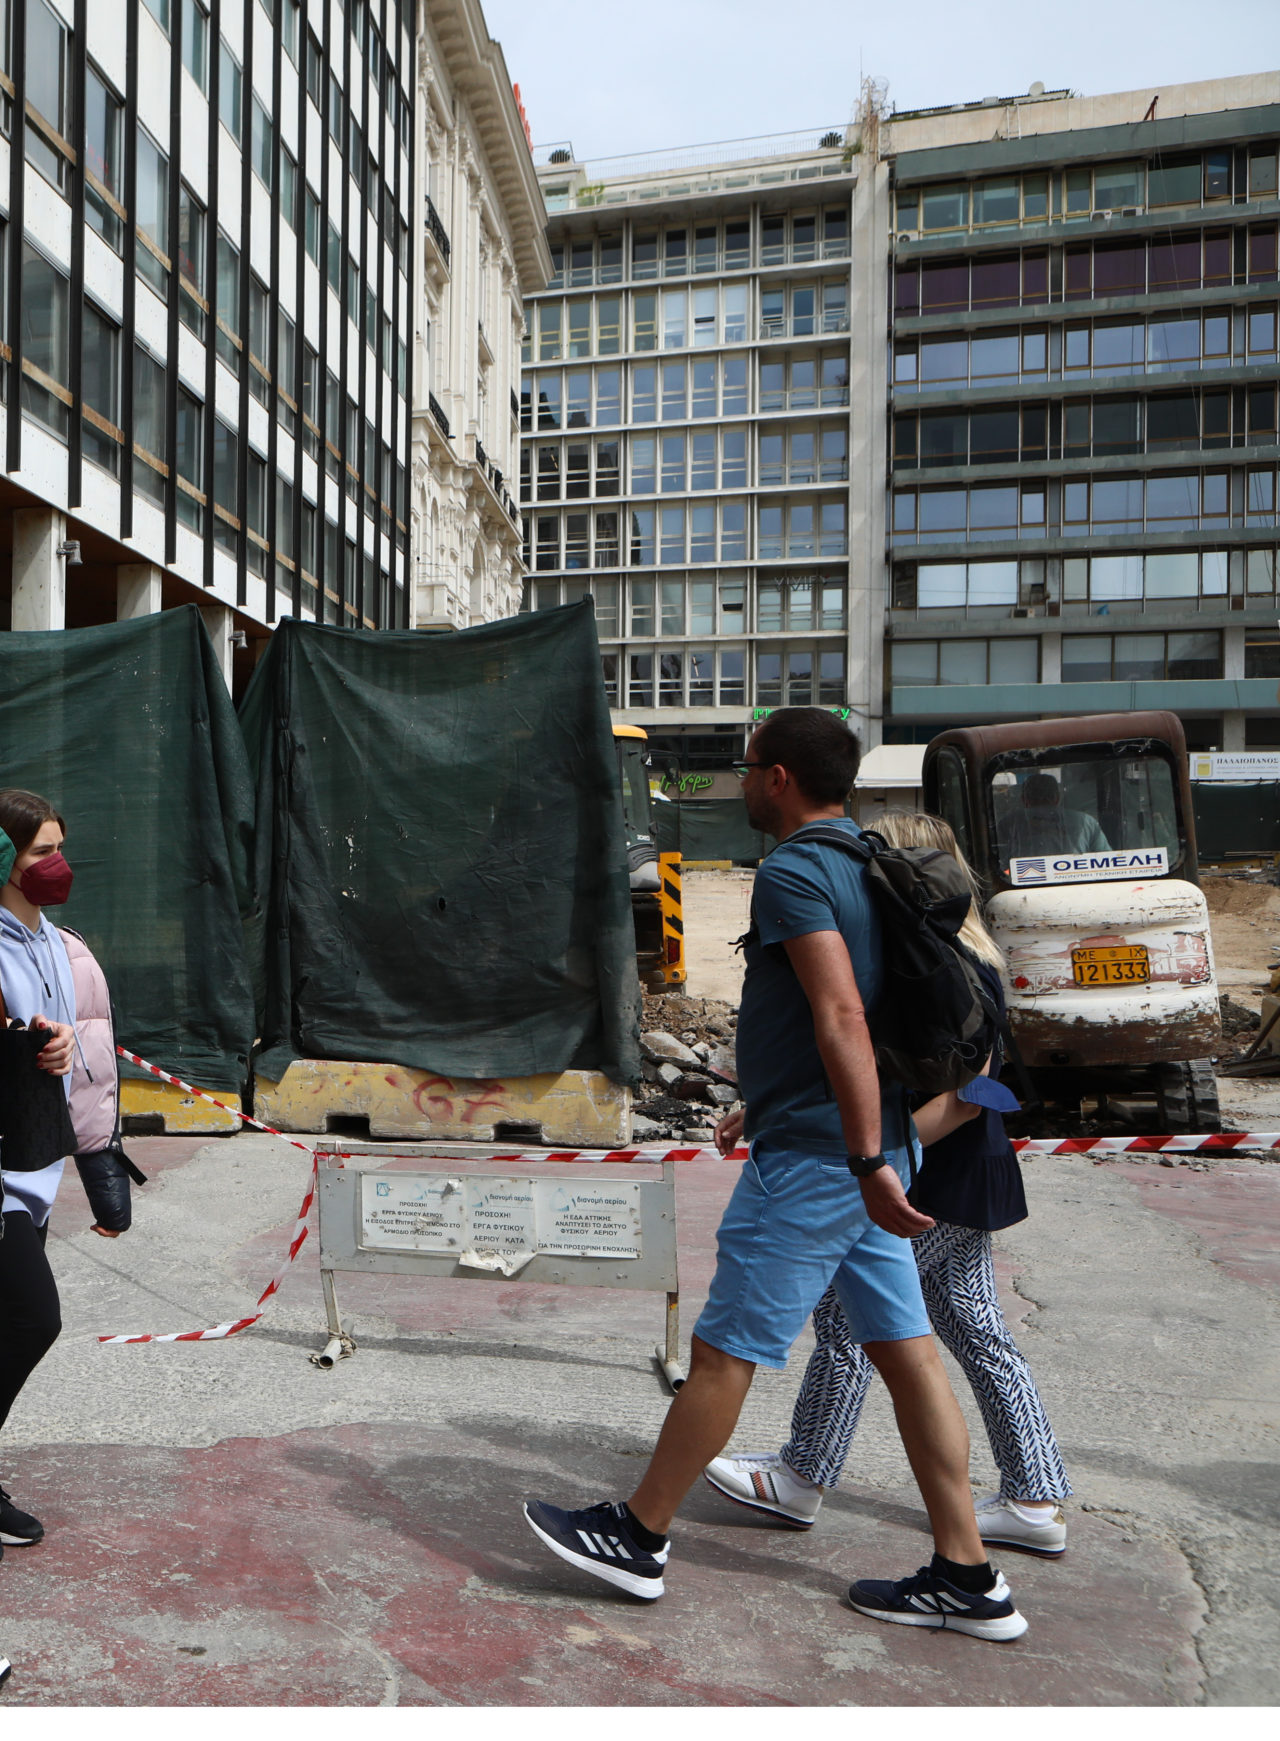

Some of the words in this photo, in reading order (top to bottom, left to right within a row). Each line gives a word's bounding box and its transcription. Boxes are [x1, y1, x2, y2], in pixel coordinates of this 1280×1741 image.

[1077, 963, 1148, 982] 121333
[604, 1198, 627, 1207] αερίου
[475, 1210, 511, 1219] ΠΡΟΣΟΧΗ!
[473, 1222, 491, 1230] ΕΡΓΑ
[505, 1236, 525, 1244] ΚΑΤΑ
